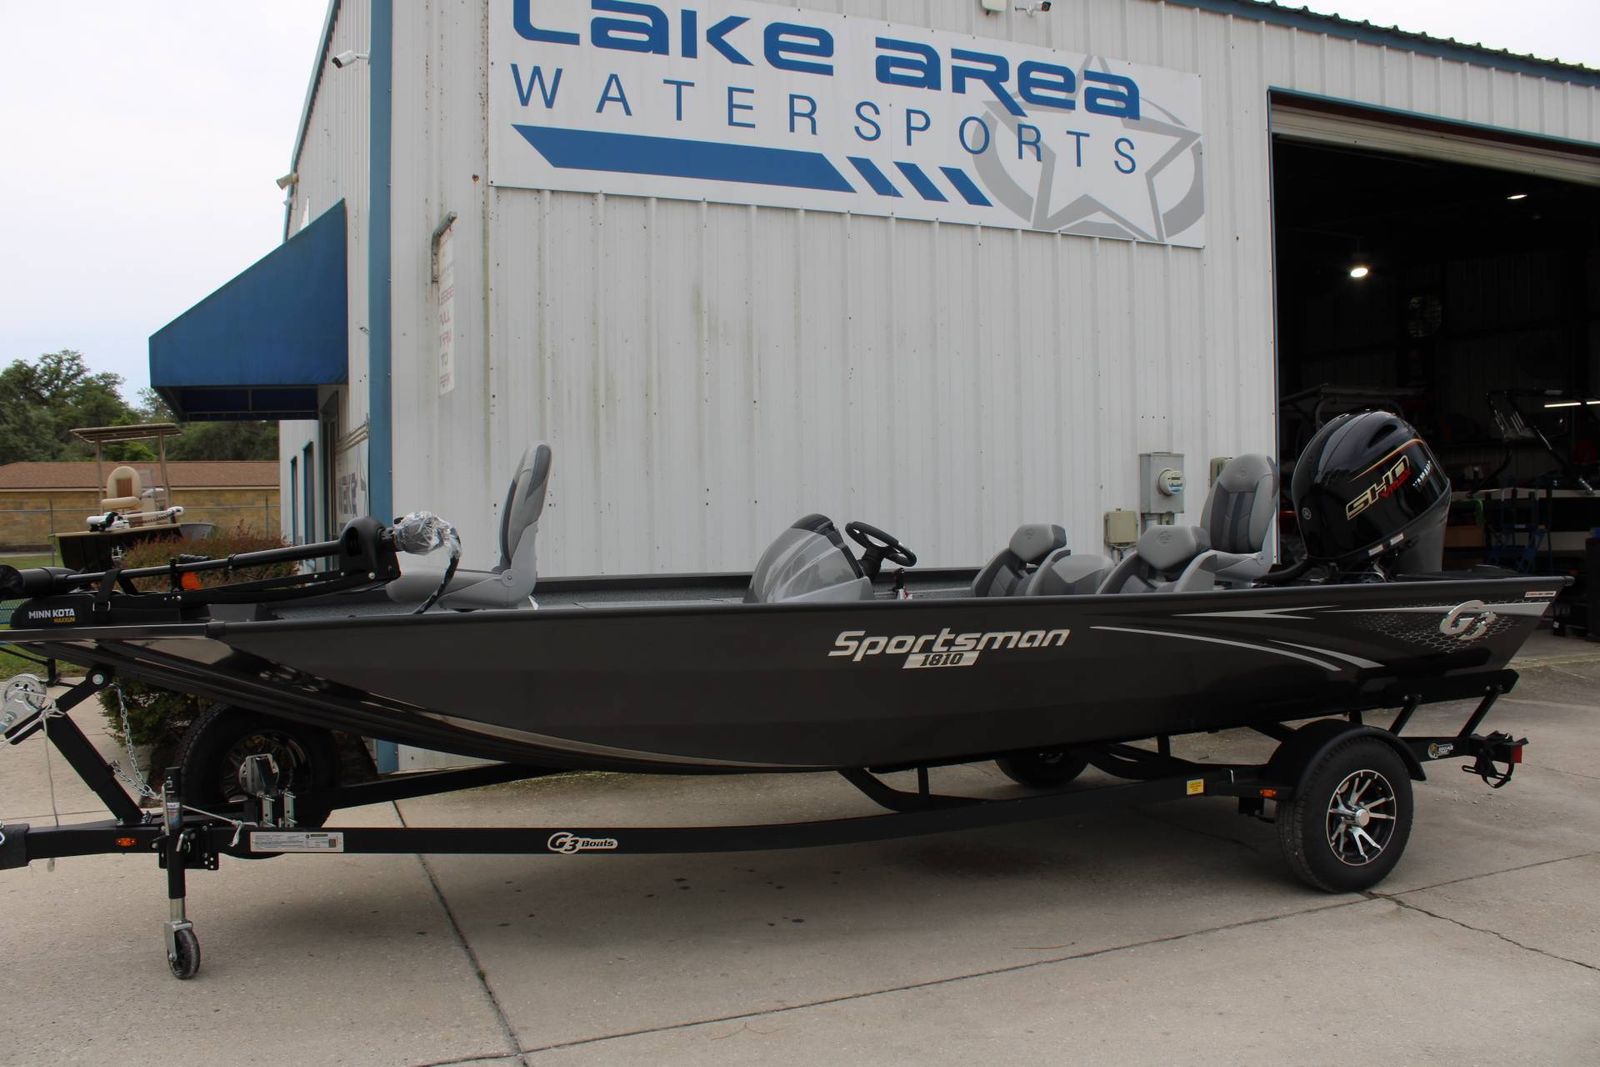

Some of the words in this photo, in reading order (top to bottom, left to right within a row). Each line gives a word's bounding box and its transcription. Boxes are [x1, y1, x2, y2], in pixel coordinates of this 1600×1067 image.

[511, 62, 1138, 174] WATERSPORTS
[1345, 455, 1410, 520] SHO
[28, 609, 51, 619] MINN
[52, 608, 75, 617] KOTA
[828, 627, 1070, 661] Sportsman
[920, 652, 965, 667] 1810
[547, 832, 580, 854] G3
[581, 839, 615, 848] Boats
